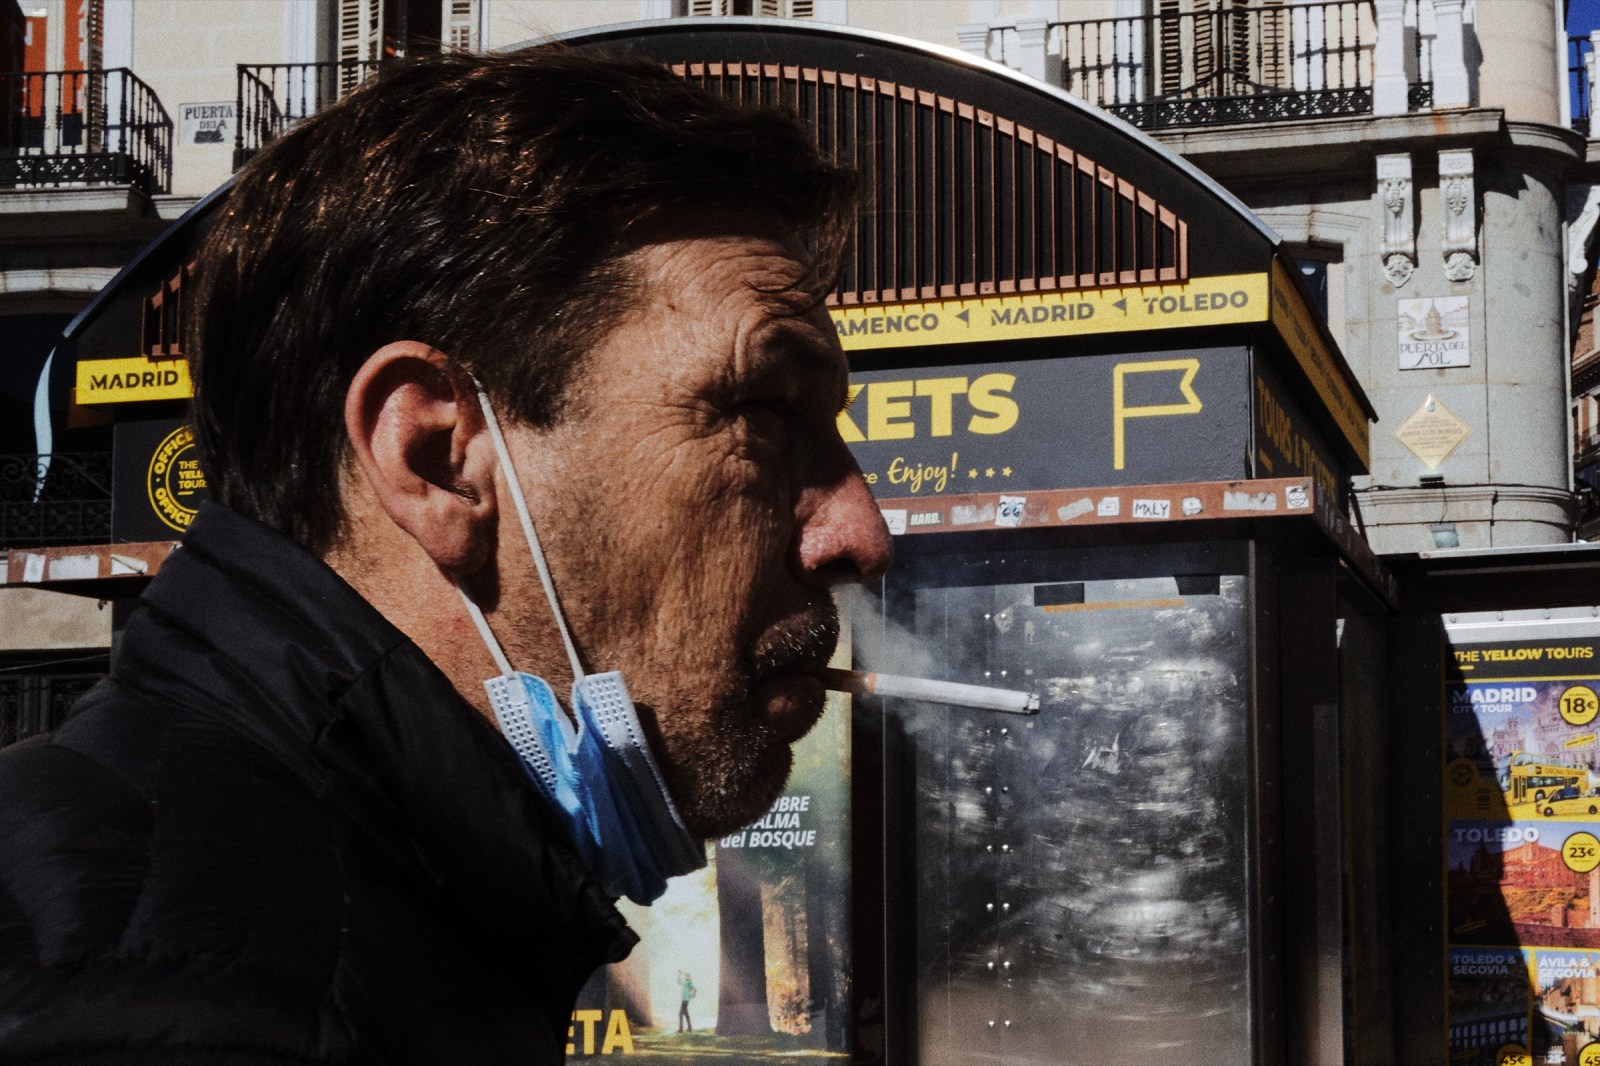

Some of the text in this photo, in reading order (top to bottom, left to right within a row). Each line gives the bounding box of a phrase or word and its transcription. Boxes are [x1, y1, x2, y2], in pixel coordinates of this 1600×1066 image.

[185, 105, 233, 120] PUERTA
[834, 312, 939, 336] AMENCO
[991, 302, 1095, 327] MADRID
[1143, 289, 1249, 316] TOLEDO
[1400, 340, 1466, 355] PUERTA DEL
[1414, 351, 1451, 367] SOL
[90, 370, 179, 391] MADRID
[178, 460, 199, 470] THE
[887, 451, 959, 493] Enjoy!
[178, 470, 205, 480] YELL
[178, 479, 208, 489] TOUR
[155, 487, 195, 526] OFFICI
[909, 512, 941, 526] HARD.
[1454, 646, 1594, 662] THE YELLOW TOURS
[1453, 687, 1537, 703] MADRID
[1452, 703, 1513, 714] CITY TOUR
[1563, 697, 1596, 714] 18€
[720, 830, 817, 850] del BOSQUE
[1454, 827, 1539, 842] TOLEDO
[1569, 846, 1595, 859] 23€
[1453, 954, 1517, 965] TOLEDO &
[1539, 955, 1591, 968] ÁVILA &
[1453, 965, 1510, 976] SEGOVIA
[1539, 968, 1596, 979] SEGOVIA
[1500, 1055, 1527, 1066] 45€
